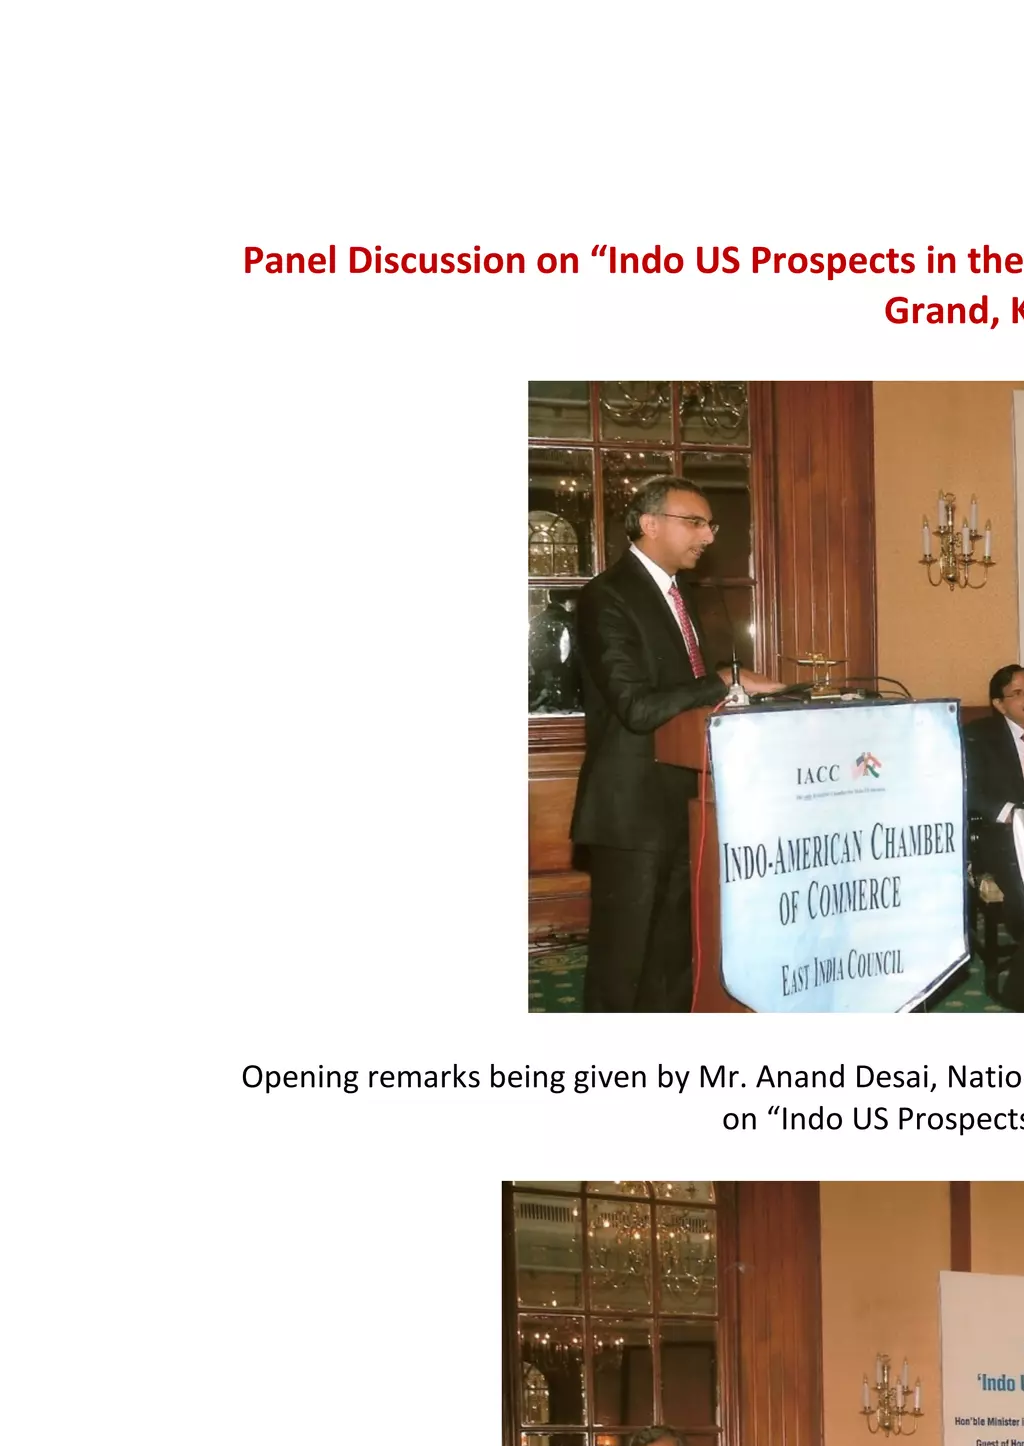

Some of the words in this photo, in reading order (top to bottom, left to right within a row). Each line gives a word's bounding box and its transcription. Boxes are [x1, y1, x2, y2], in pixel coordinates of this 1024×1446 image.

[244, 244, 336, 275] Panel
[349, 244, 526, 275] Discussion
[536, 252, 579, 275] on
[590, 244, 685, 275] “Indo
[696, 245, 741, 275] US
[752, 246, 916, 281] Prospects
[927, 244, 957, 274] in
[967, 244, 1024, 275] the
[884, 294, 1000, 330] Grand,
[796, 764, 841, 785] IACC
